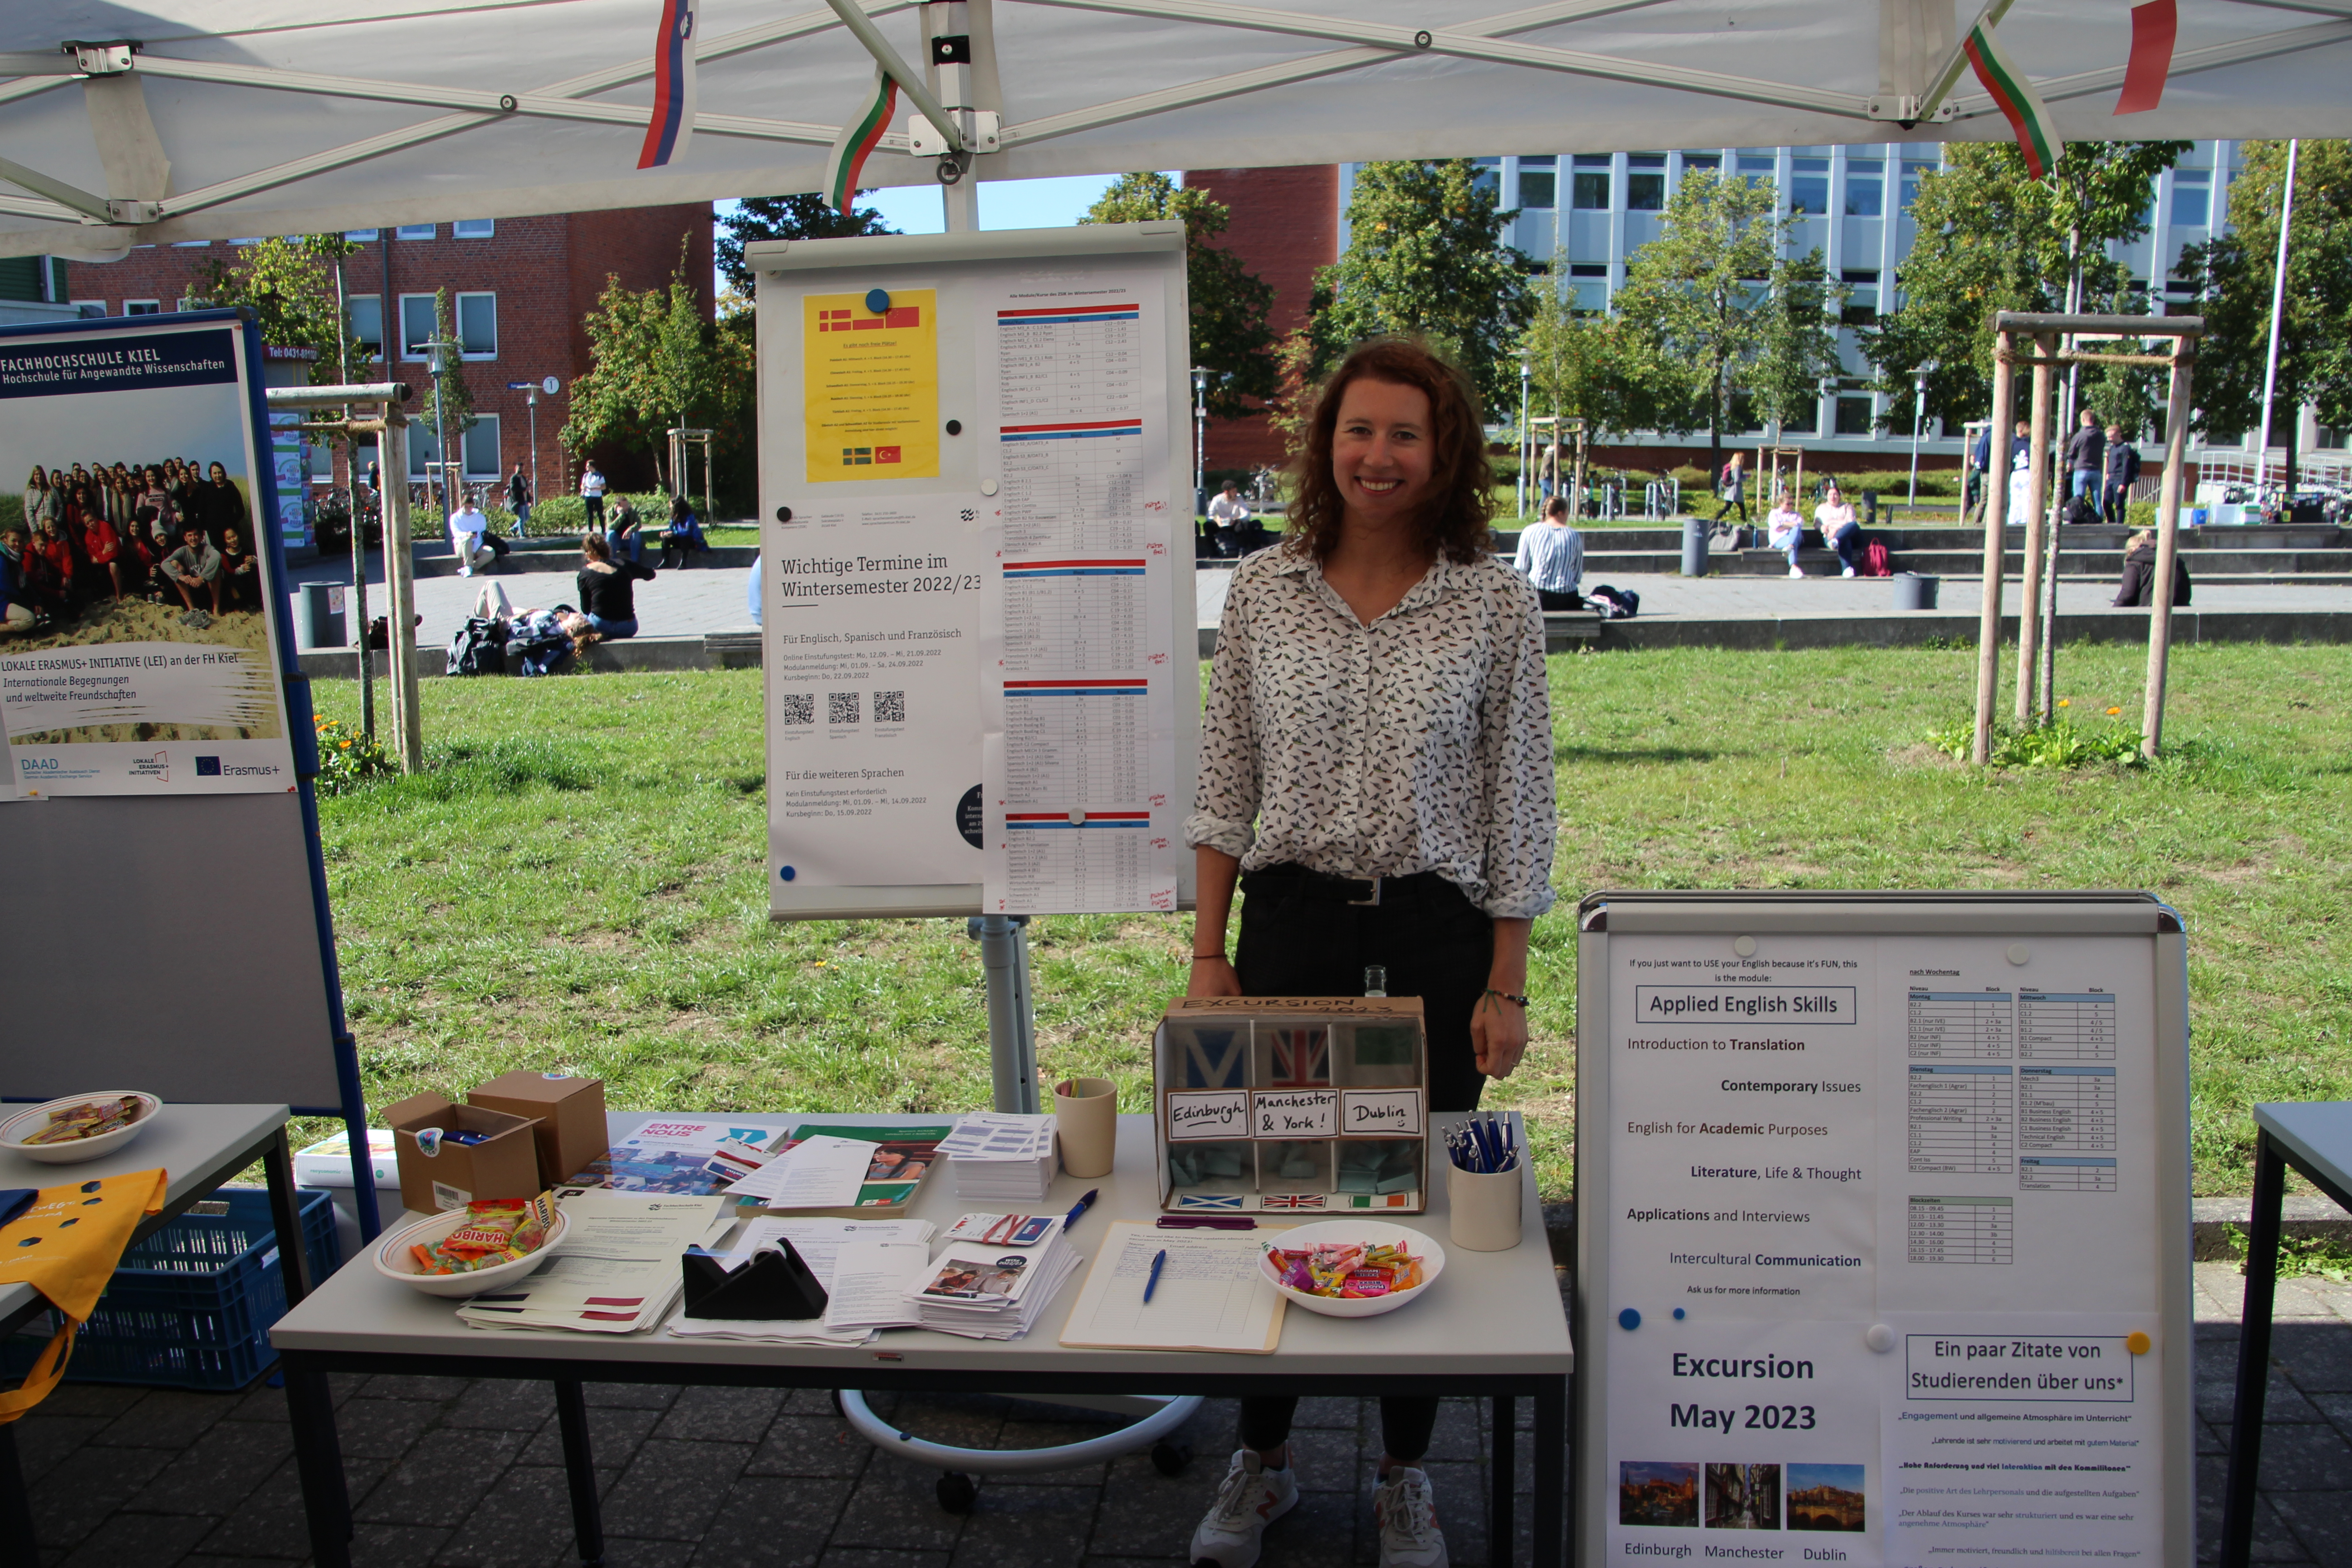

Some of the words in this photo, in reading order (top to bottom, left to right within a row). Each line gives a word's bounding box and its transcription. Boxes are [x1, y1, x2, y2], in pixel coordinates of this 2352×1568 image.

[270, 347, 282, 357] Tel:
[0, 351, 123, 372] FACHHOCHSCHULE
[127, 348, 161, 363] KIEL
[3, 371, 59, 384] Hochschule
[62, 369, 77, 380] für
[80, 365, 142, 381] Angewandte
[144, 359, 225, 374] Wissenschaften
[550, 381, 552, 390] 1
[781, 557, 853, 577] Wichtige
[857, 554, 923, 571] Termine
[927, 553, 948, 568] im
[782, 579, 909, 597] Wintersemester
[913, 574, 980, 595] 2022/23
[783, 635, 798, 644] Für
[800, 633, 842, 645] Englisch,
[844, 631, 886, 644] Spanisch
[887, 630, 906, 640] und
[908, 628, 961, 640] Französisch
[1, 660, 36, 671] LOKALE
[38, 659, 88, 670] ERASMUS+
[89, 657, 141, 668] INITIATIVE
[144, 655, 167, 670] (LEI)
[170, 657, 182, 666] an
[184, 654, 200, 665] der
[202, 653, 216, 664] FH
[218, 652, 239, 663] Kiel
[804, 653, 855, 661] Einstufungstest:
[3, 676, 67, 688] Internationale
[69, 676, 129, 688] Begegnungen
[784, 673, 820, 682] Kursbeginn:
[6, 692, 23, 702] und
[24, 691, 67, 702] weltweite
[69, 689, 136, 701] Freundschaften
[21, 758, 59, 771] DAAD
[223, 765, 280, 776] Erasmus+
[786, 771, 800, 780] Für
[803, 770, 817, 779] die
[819, 769, 859, 779] weiteren
[861, 768, 904, 780] Sprachen
[800, 789, 849, 798] Einstufungstest
[786, 810, 823, 818] Kursbeginn:
[1630, 959, 1636, 967] If
[1654, 959, 1669, 969] just
[1742, 960, 1770, 969] English
[1772, 960, 1805, 968] because
[1821, 960, 1841, 969] FUN,
[1842, 960, 1857, 968] this
[1715, 974, 1721, 982] is
[1723, 974, 1737, 982] the
[1739, 974, 1771, 982] module:
[1182, 998, 1355, 1009] EXCURSION
[1650, 995, 1718, 1015] Applied
[1725, 995, 1787, 1016] English
[1793, 995, 1837, 1013] Skills
[1628, 1038, 1708, 1050] Introduction
[1712, 1039, 1726, 1050] to
[1730, 1039, 1805, 1051] Translation
[1721, 1080, 1818, 1095] Contemporary
[1823, 1081, 1861, 1093] Issues
[1255, 1094, 1337, 1109] Manchester
[1173, 1101, 1245, 1123] Edinburgh
[1353, 1104, 1406, 1122] Dublin
[648, 1123, 706, 1132] ENTRE
[1263, 1116, 1274, 1131] &
[1628, 1121, 1672, 1136] English
[1676, 1122, 1696, 1134] for
[1699, 1122, 1764, 1135] Academic
[1769, 1123, 1828, 1138] Purposes
[641, 1129, 692, 1137] NOUS
[1691, 1166, 1760, 1180] Literature,
[1766, 1166, 1788, 1179] Life
[1793, 1167, 1803, 1179] &
[1807, 1167, 1862, 1182] Thought
[537, 1197, 550, 1229] HARIBO
[1627, 1208, 1710, 1222] Applications
[1714, 1210, 1738, 1221] and
[1743, 1210, 1810, 1222] Interviews
[451, 1230, 505, 1244] HARIBO
[1671, 1252, 1750, 1265] Intercultural
[1755, 1254, 1861, 1267] Communication
[1687, 1285, 1701, 1294] Ask
[1715, 1285, 1727, 1294] for
[1752, 1286, 1800, 1295] information
[1935, 1341, 1960, 1357] Ein
[1967, 1345, 2007, 1360] paar
[2011, 1342, 2063, 1358] Zitate
[2068, 1346, 2100, 1358] von
[1673, 1352, 1813, 1379] Excursion
[1911, 1372, 2031, 1389] Studierenden
[2038, 1373, 2079, 1389] über
[1671, 1403, 1735, 1434] May
[1744, 1405, 1816, 1430] 2023
[1625, 1543, 1691, 1559] Edinburgh
[1705, 1545, 1784, 1559] Manchester
[1804, 1548, 1846, 1561] Dublin
